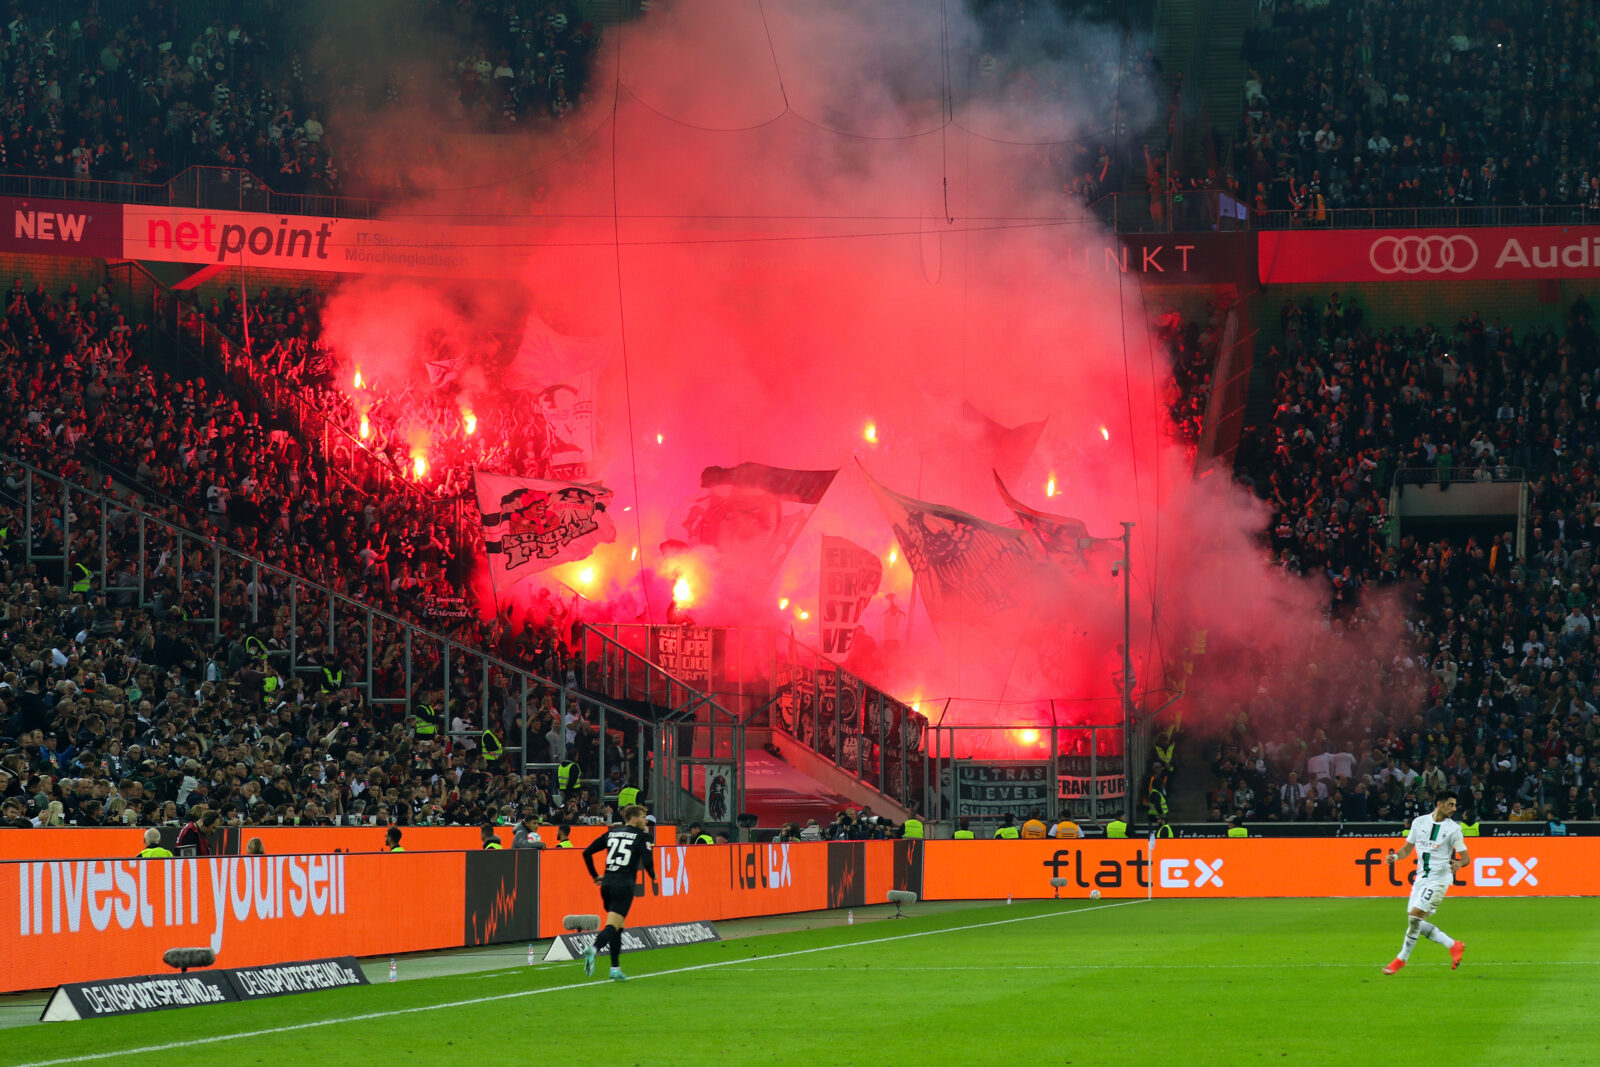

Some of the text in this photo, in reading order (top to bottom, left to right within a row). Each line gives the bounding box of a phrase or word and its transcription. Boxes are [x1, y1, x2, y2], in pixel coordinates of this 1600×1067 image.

[14, 210, 86, 242] NEW
[147, 216, 333, 261] netpoint
[1494, 236, 1600, 268] Audi
[964, 767, 1043, 781] ULTRAS
[1058, 778, 1125, 795] FRANKFUR
[970, 786, 1038, 799] NEVER
[606, 837, 632, 867] 25
[1421, 887, 1434, 901] 13
[235, 960, 360, 997] DEINSPORTSFREUND.DE
[81, 977, 226, 1014] DEINSPORTSFREUND.DE
